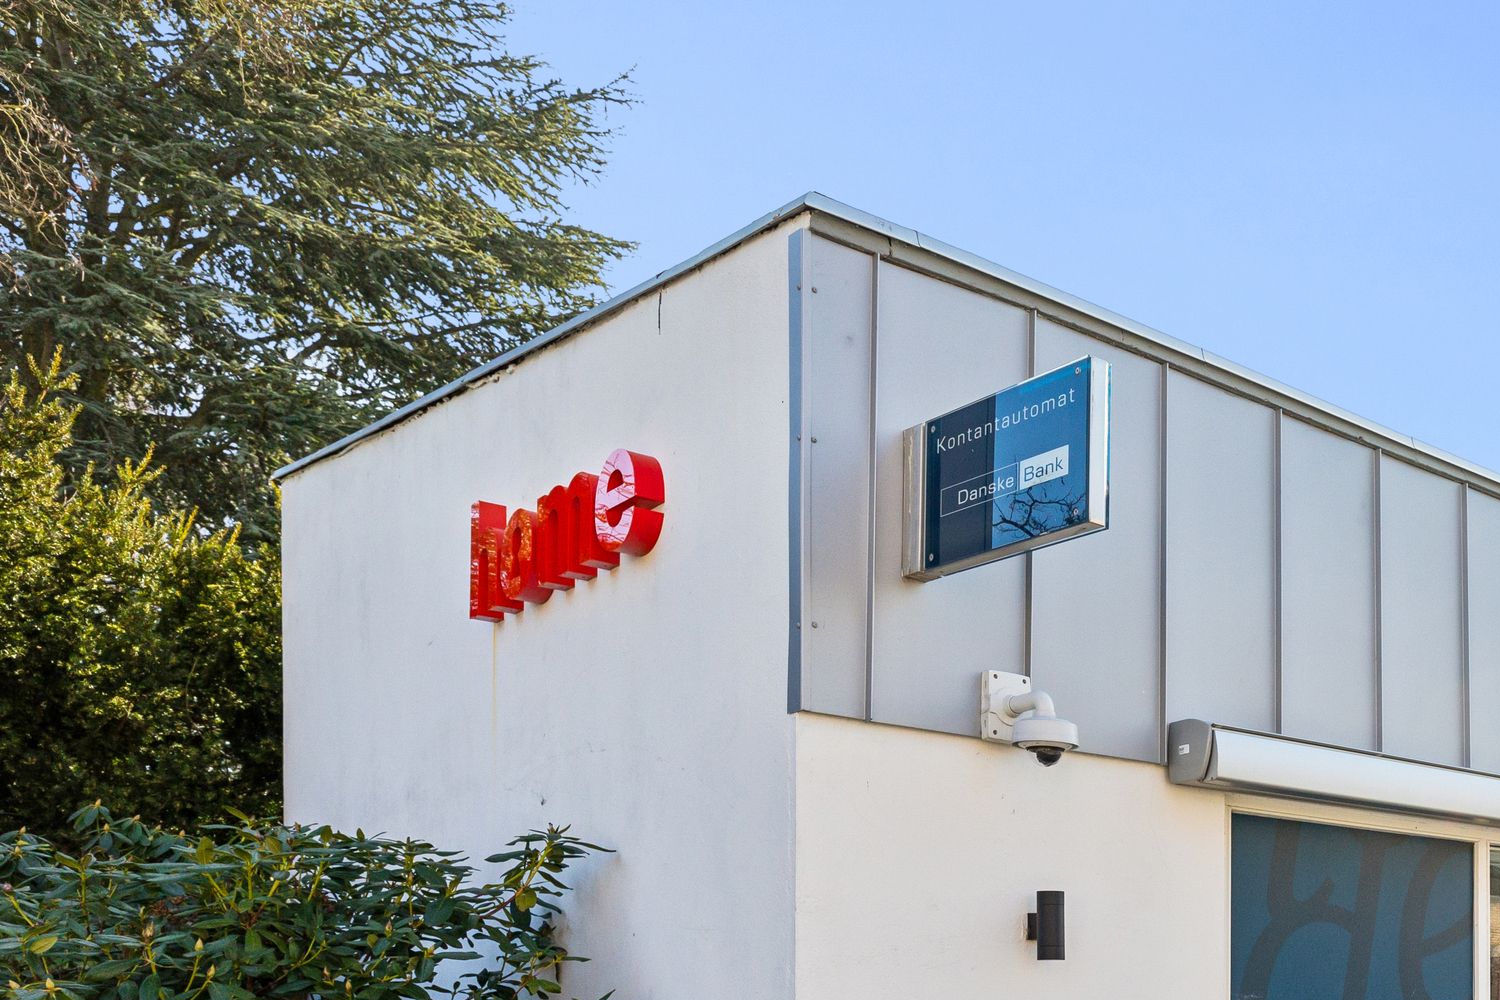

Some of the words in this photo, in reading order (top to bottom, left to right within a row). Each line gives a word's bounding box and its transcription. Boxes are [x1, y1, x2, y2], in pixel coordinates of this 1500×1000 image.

[936, 387, 1076, 455] Kontantautomat
[957, 474, 1015, 506] Danske
[1023, 456, 1064, 483] Bank
